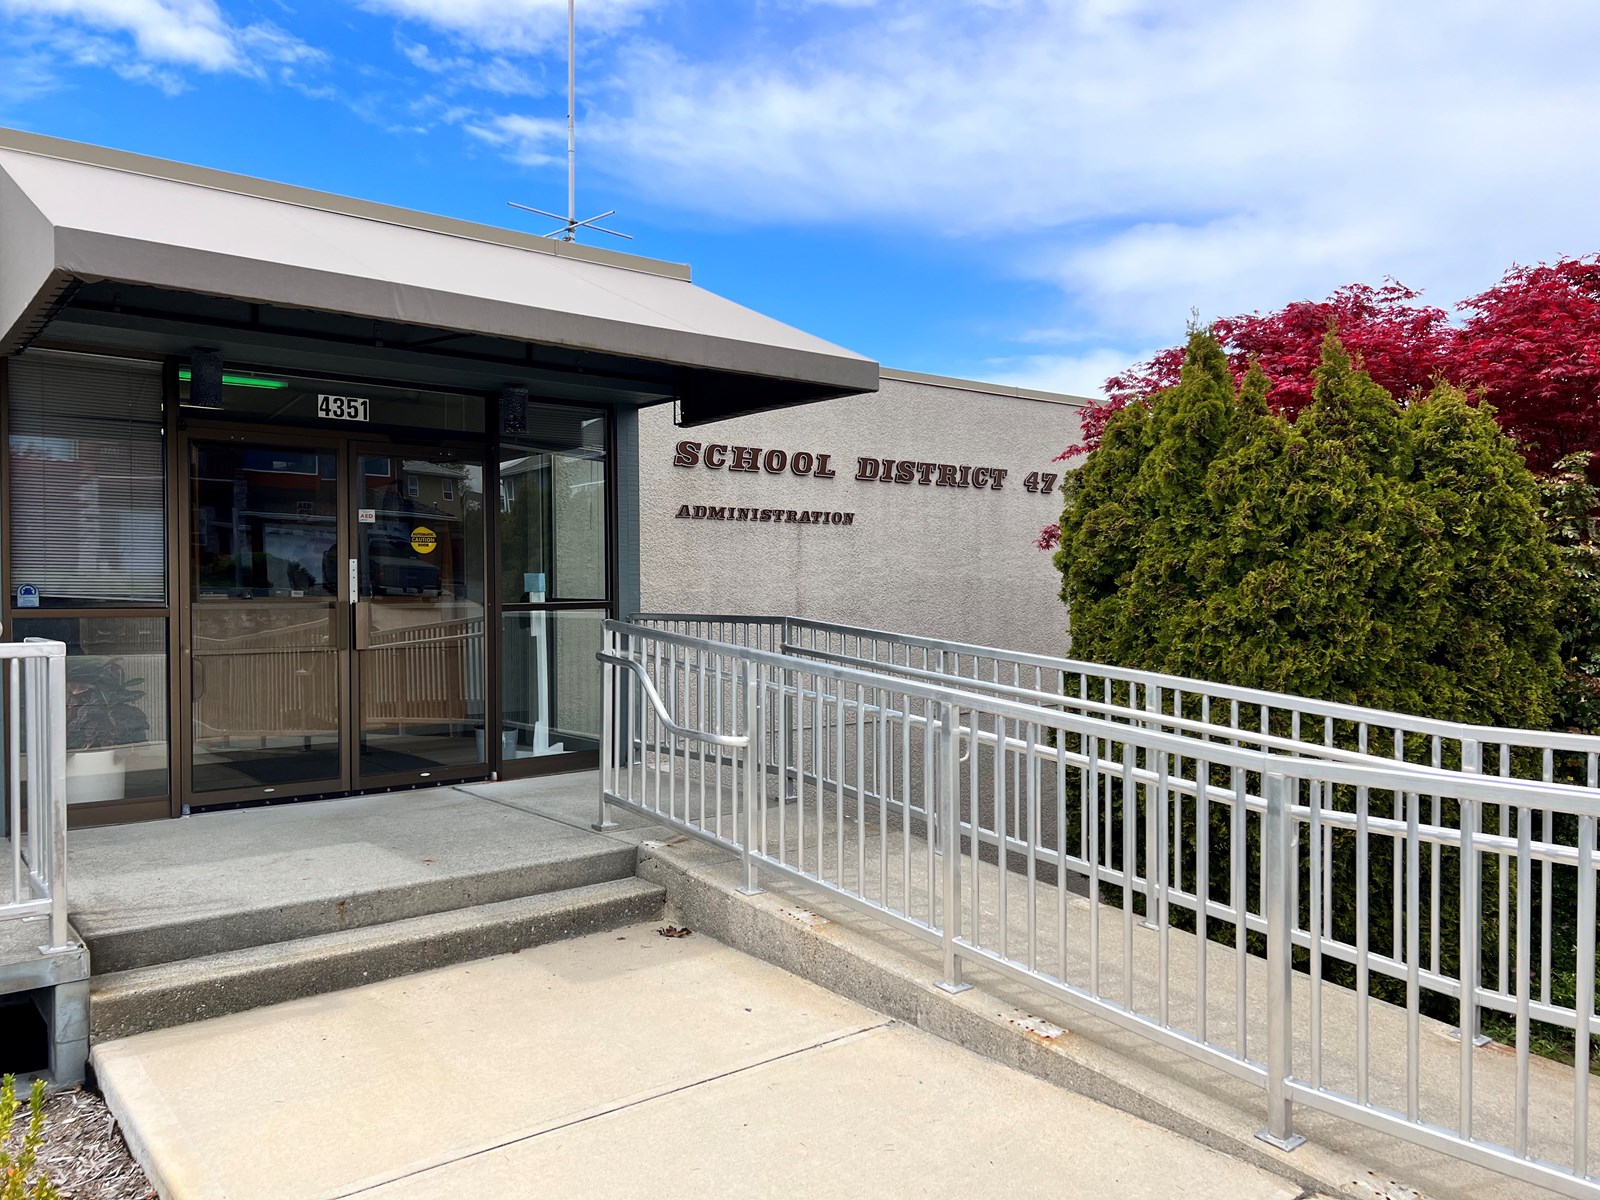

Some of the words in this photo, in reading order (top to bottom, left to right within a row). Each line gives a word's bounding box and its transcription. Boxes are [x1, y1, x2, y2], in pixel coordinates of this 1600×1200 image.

[319, 395, 368, 421] 4351
[674, 440, 836, 479] SCHOOL
[855, 456, 1008, 490] DISTRICT
[1023, 471, 1058, 493] 47
[675, 504, 855, 525] ADMINISTRATION
